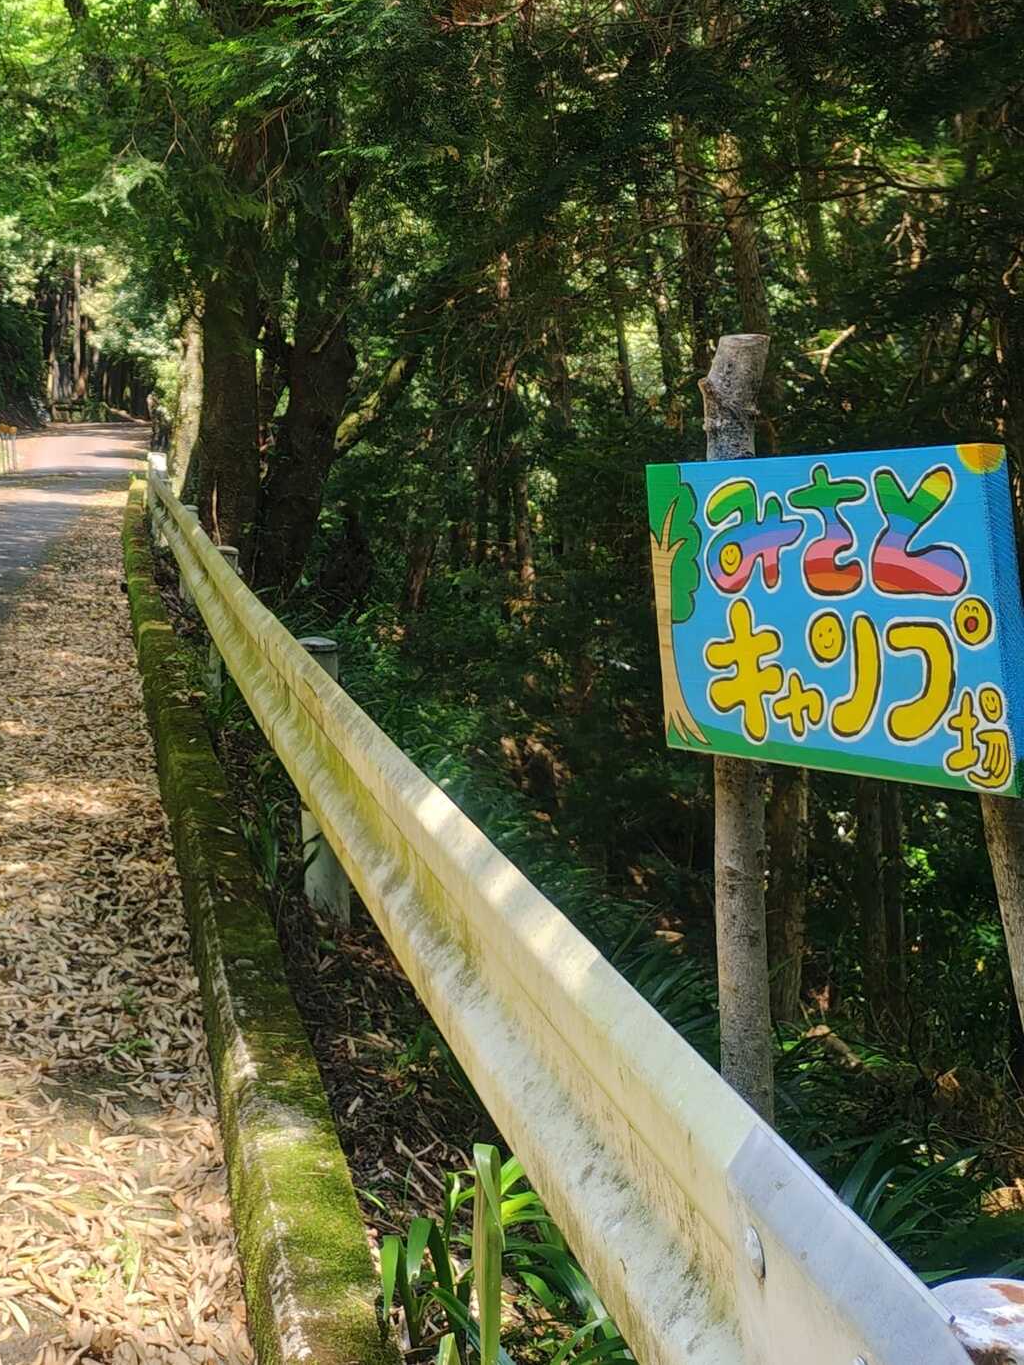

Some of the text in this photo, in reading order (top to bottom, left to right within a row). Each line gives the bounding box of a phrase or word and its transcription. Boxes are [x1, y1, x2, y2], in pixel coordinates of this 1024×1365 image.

[706, 465, 968, 596] みさと
[706, 597, 1011, 788] キャンプ場
